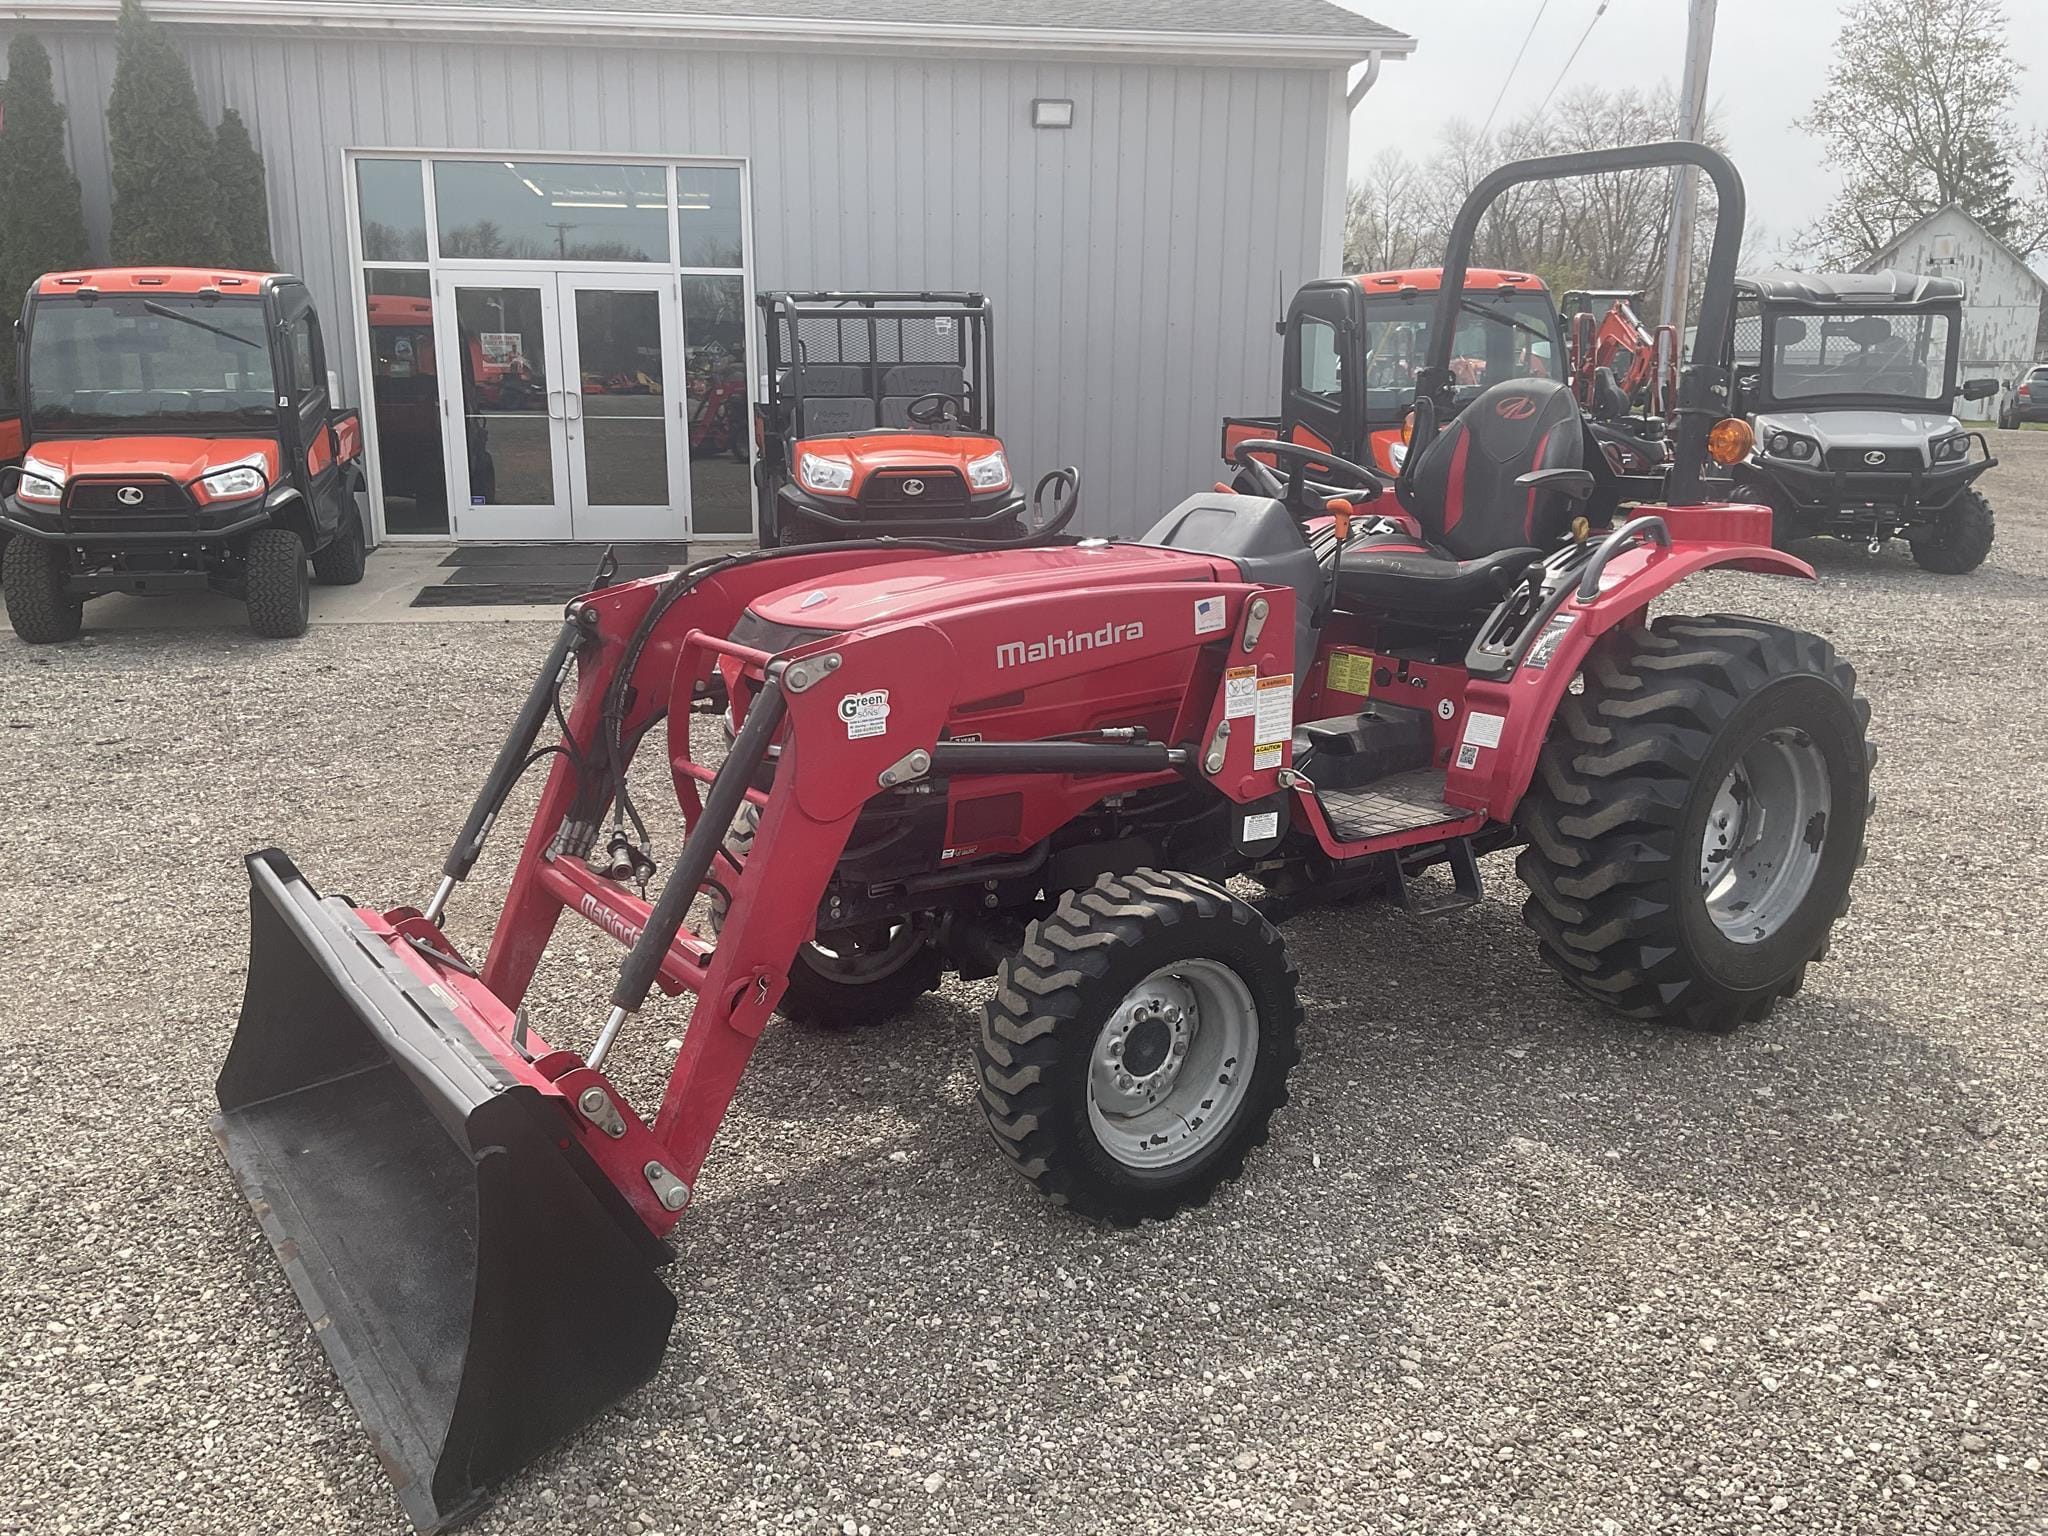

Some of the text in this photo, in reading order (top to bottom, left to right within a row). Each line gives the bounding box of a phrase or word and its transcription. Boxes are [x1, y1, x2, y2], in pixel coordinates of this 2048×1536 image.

[996, 621, 1144, 669] Mahindra
[841, 695, 883, 718] Green
[1442, 702, 1450, 715] 5
[857, 709, 879, 718] SONS
[1259, 743, 1281, 752] CAUTION
